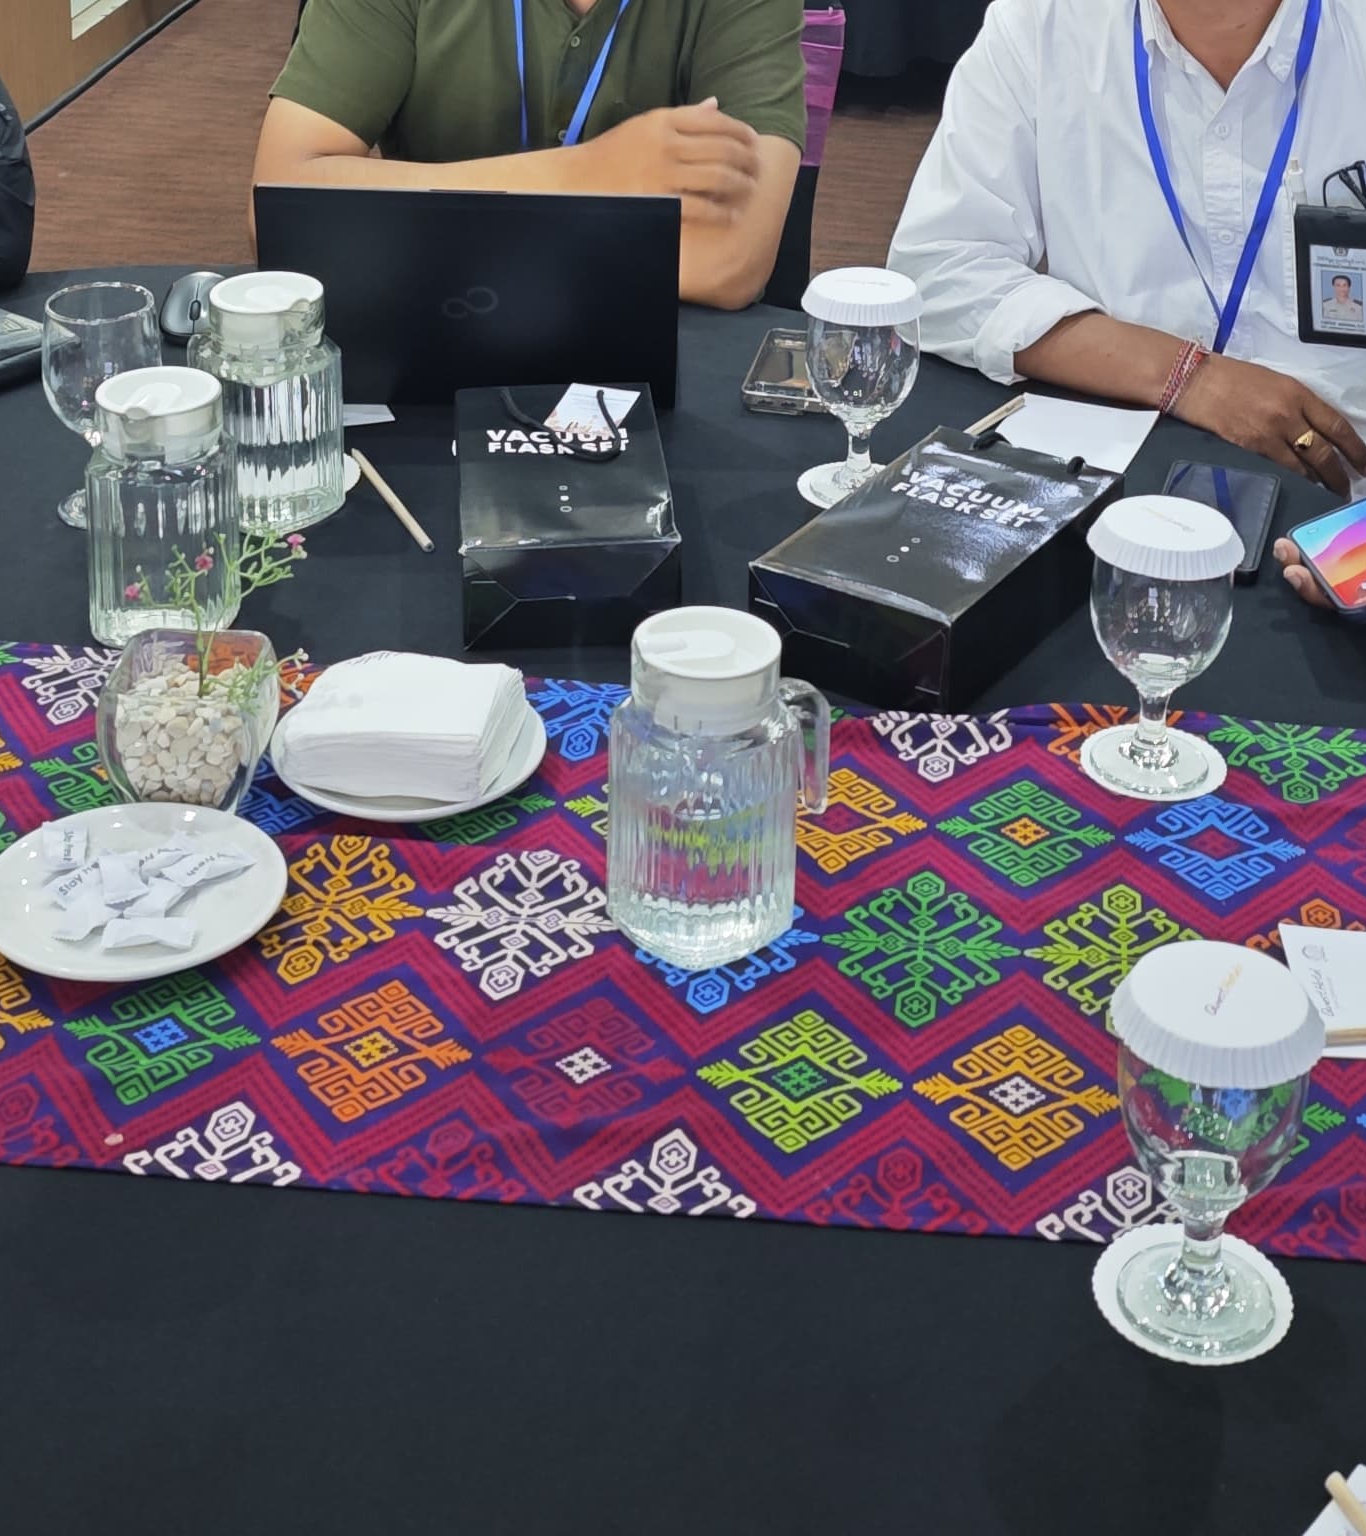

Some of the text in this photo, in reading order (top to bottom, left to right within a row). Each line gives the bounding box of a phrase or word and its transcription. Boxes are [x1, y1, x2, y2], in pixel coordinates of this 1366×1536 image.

[488, 441, 575, 454] FLASK
[891, 481, 1032, 528] FLASK SET
[909, 471, 1045, 518] VACUUM
